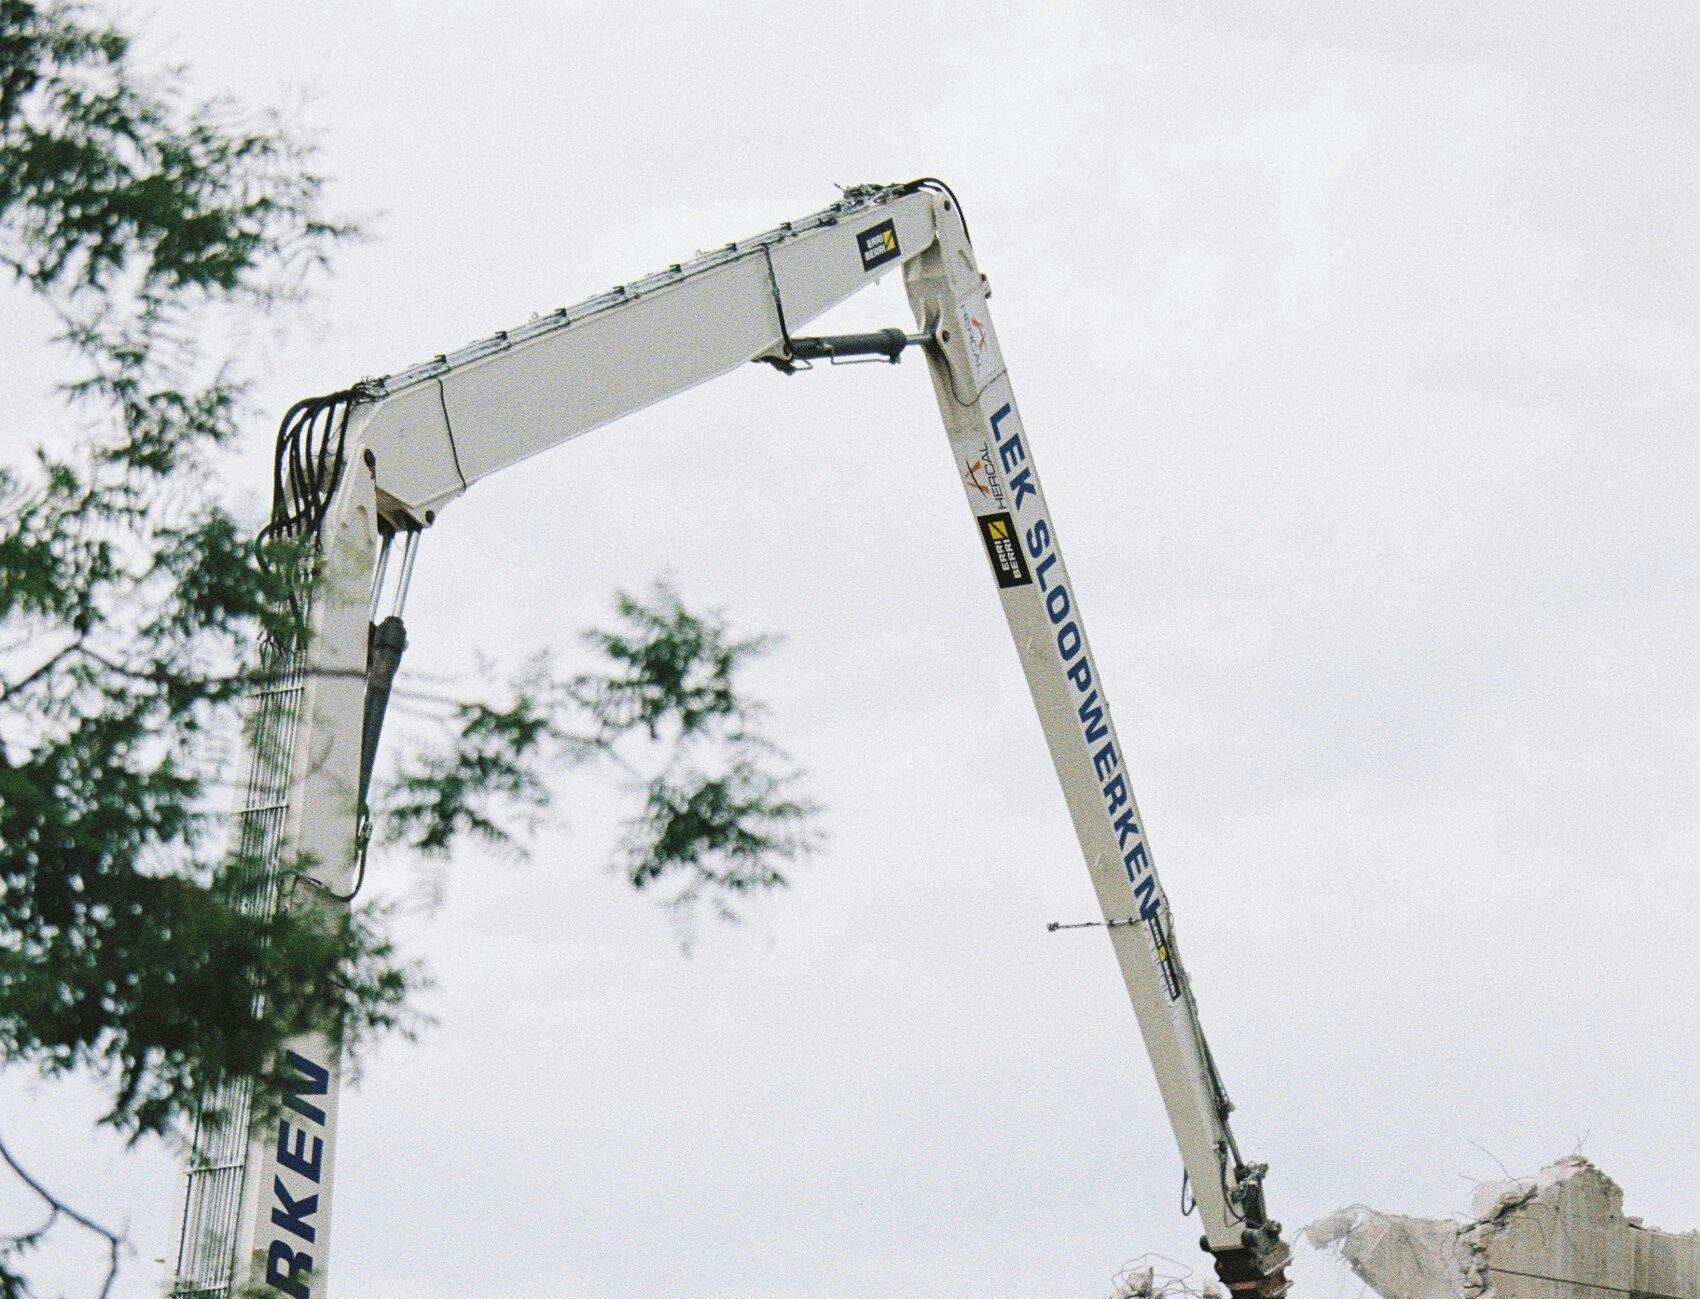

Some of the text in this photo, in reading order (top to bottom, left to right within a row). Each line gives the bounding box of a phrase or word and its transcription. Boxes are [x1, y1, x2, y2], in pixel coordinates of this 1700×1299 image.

[983, 441, 1007, 509] HERCAL
[995, 540, 1010, 572] ERRI
[1001, 538, 1022, 579] BERRI
[989, 402, 1163, 922] LEK SLOOPWERKEN
